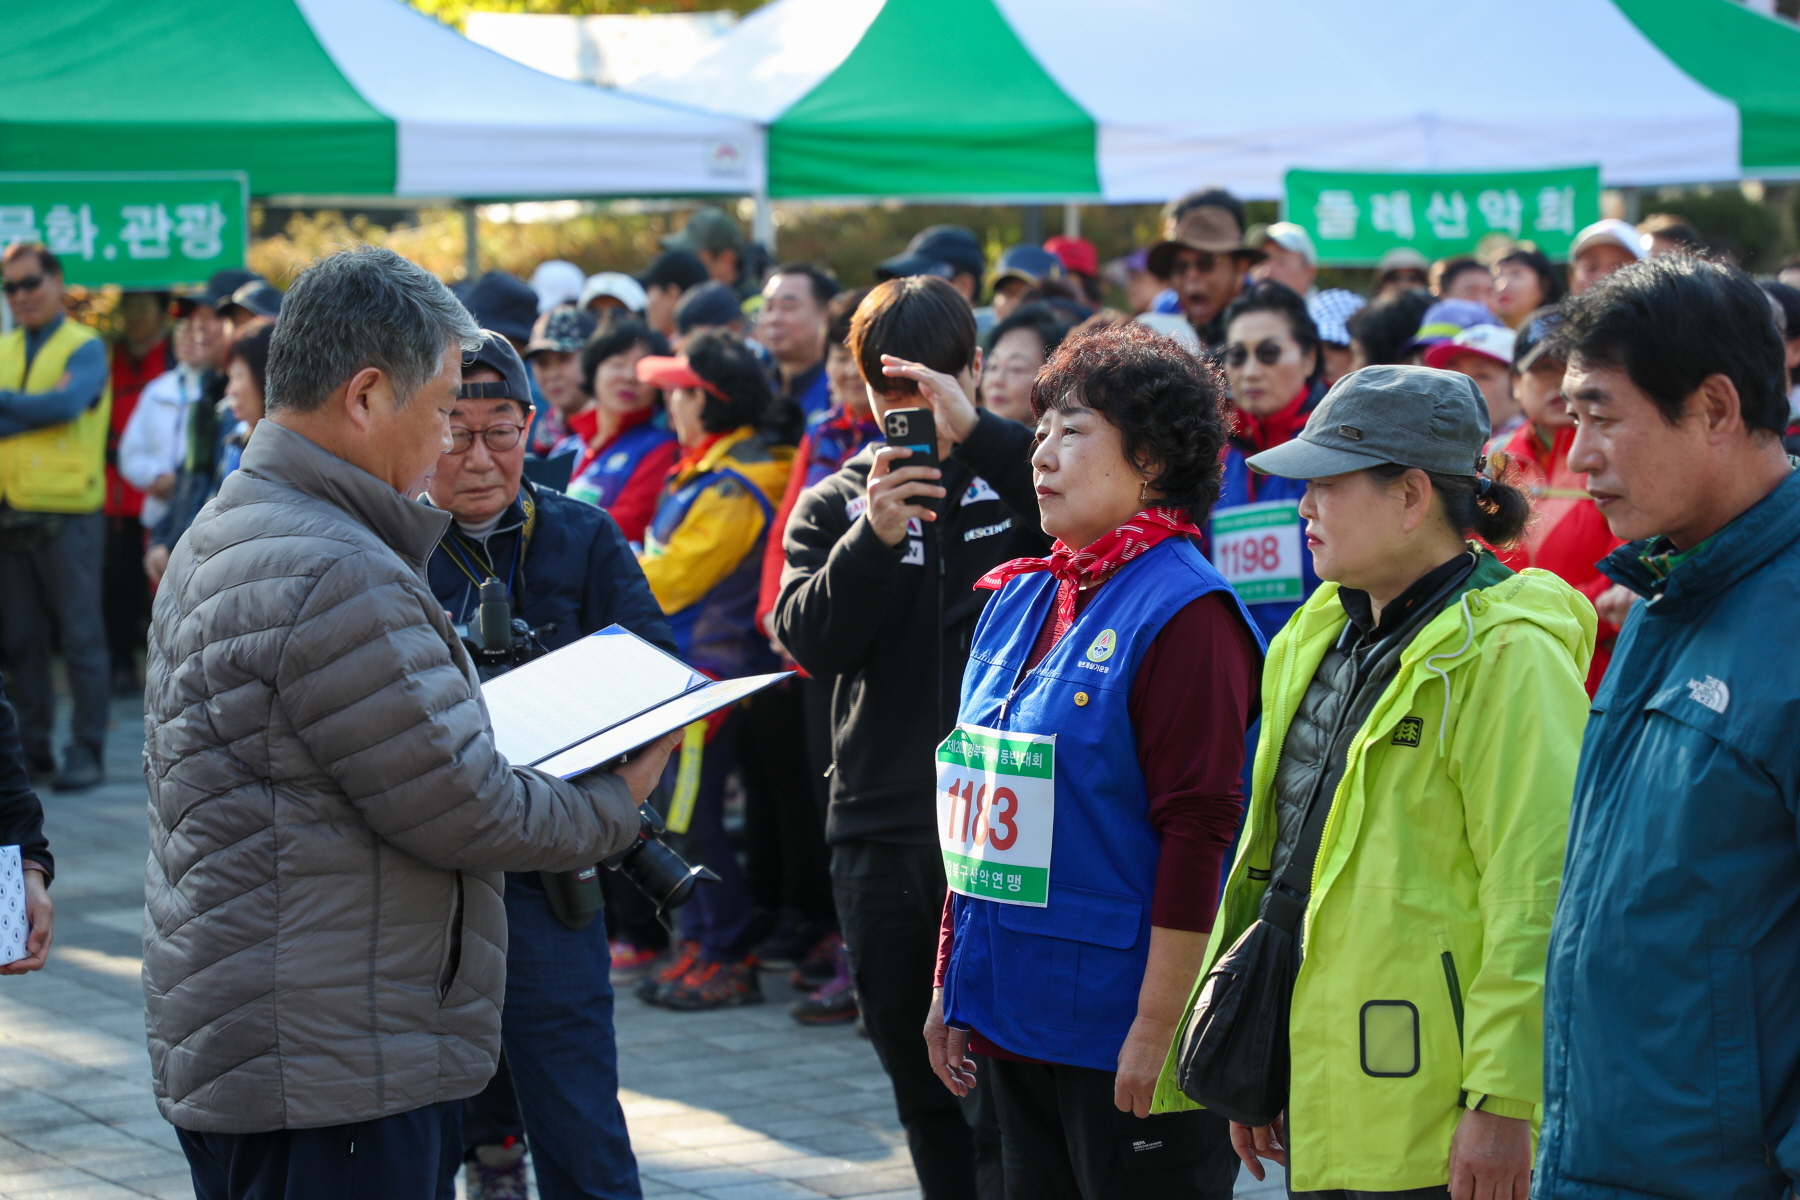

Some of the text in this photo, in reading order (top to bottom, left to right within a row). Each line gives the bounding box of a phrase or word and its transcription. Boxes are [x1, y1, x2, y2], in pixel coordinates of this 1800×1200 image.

[964, 518, 1012, 542] DESCENTE
[1220, 534, 1281, 577] 1198
[1000, 748, 1043, 769] 등반대회
[948, 777, 1019, 851] 1183
